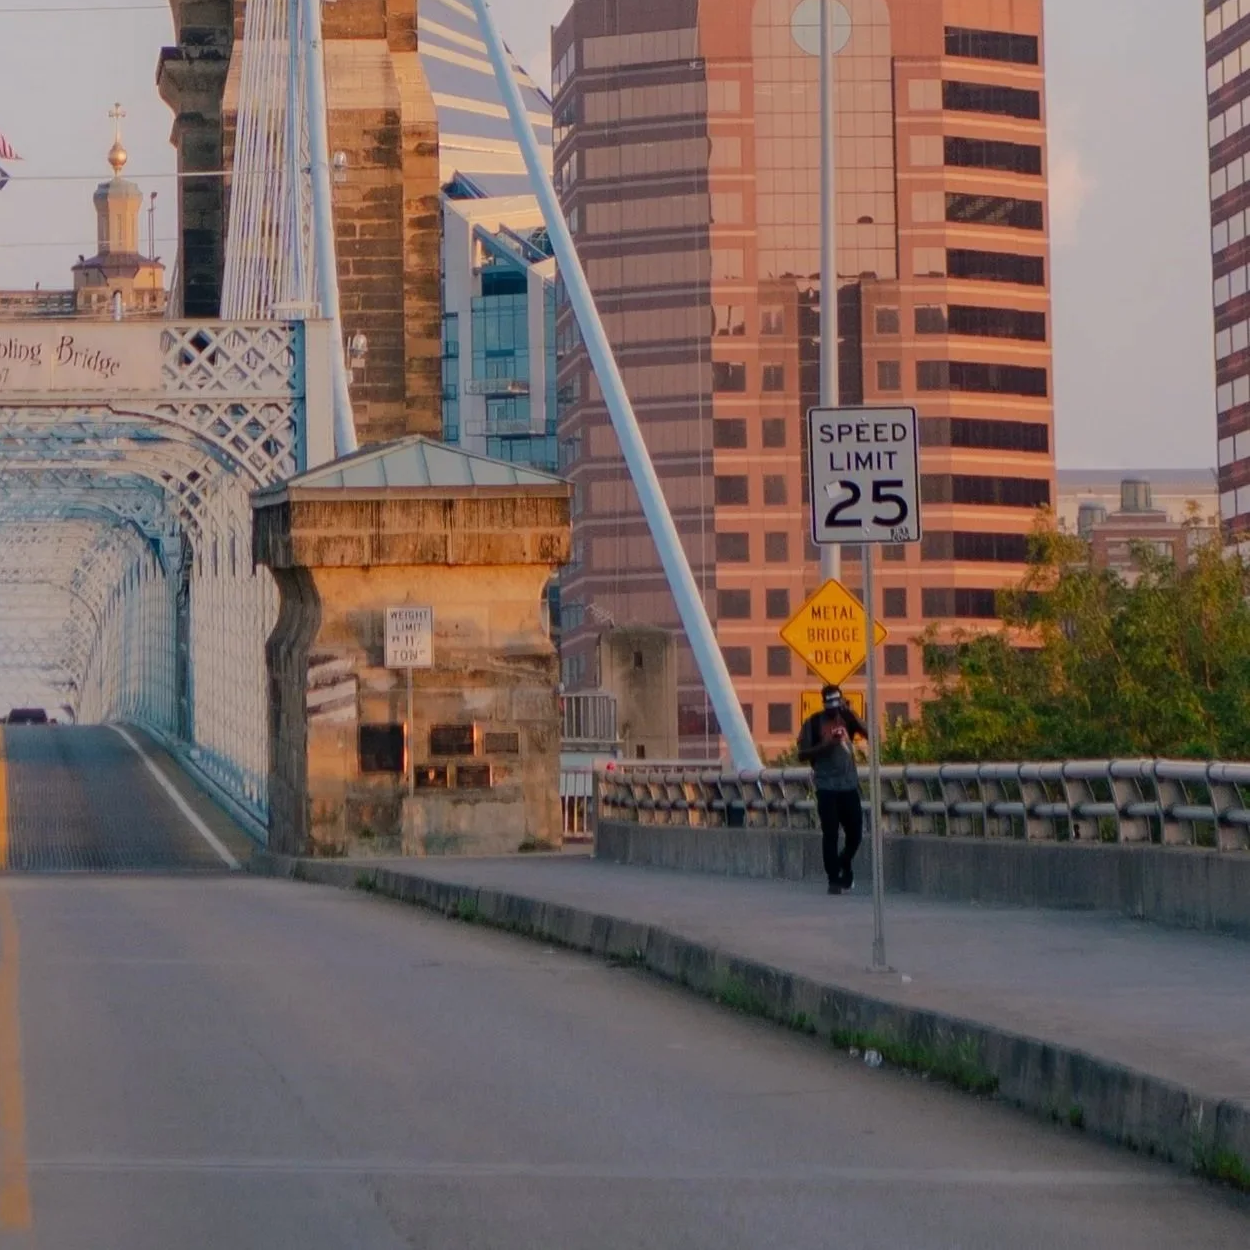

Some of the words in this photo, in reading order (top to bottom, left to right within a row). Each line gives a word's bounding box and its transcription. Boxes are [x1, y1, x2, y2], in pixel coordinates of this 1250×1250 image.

[56, 335, 121, 378] Bridge
[819, 423, 907, 443] SPEED
[829, 451, 897, 471] LIMIT
[824, 480, 909, 528] 25
[390, 610, 429, 620] WEIGHT
[811, 605, 857, 621] METAL
[395, 622, 422, 632] LIMIT
[807, 627, 859, 643] BRIDGE
[814, 648, 852, 664] DECK
